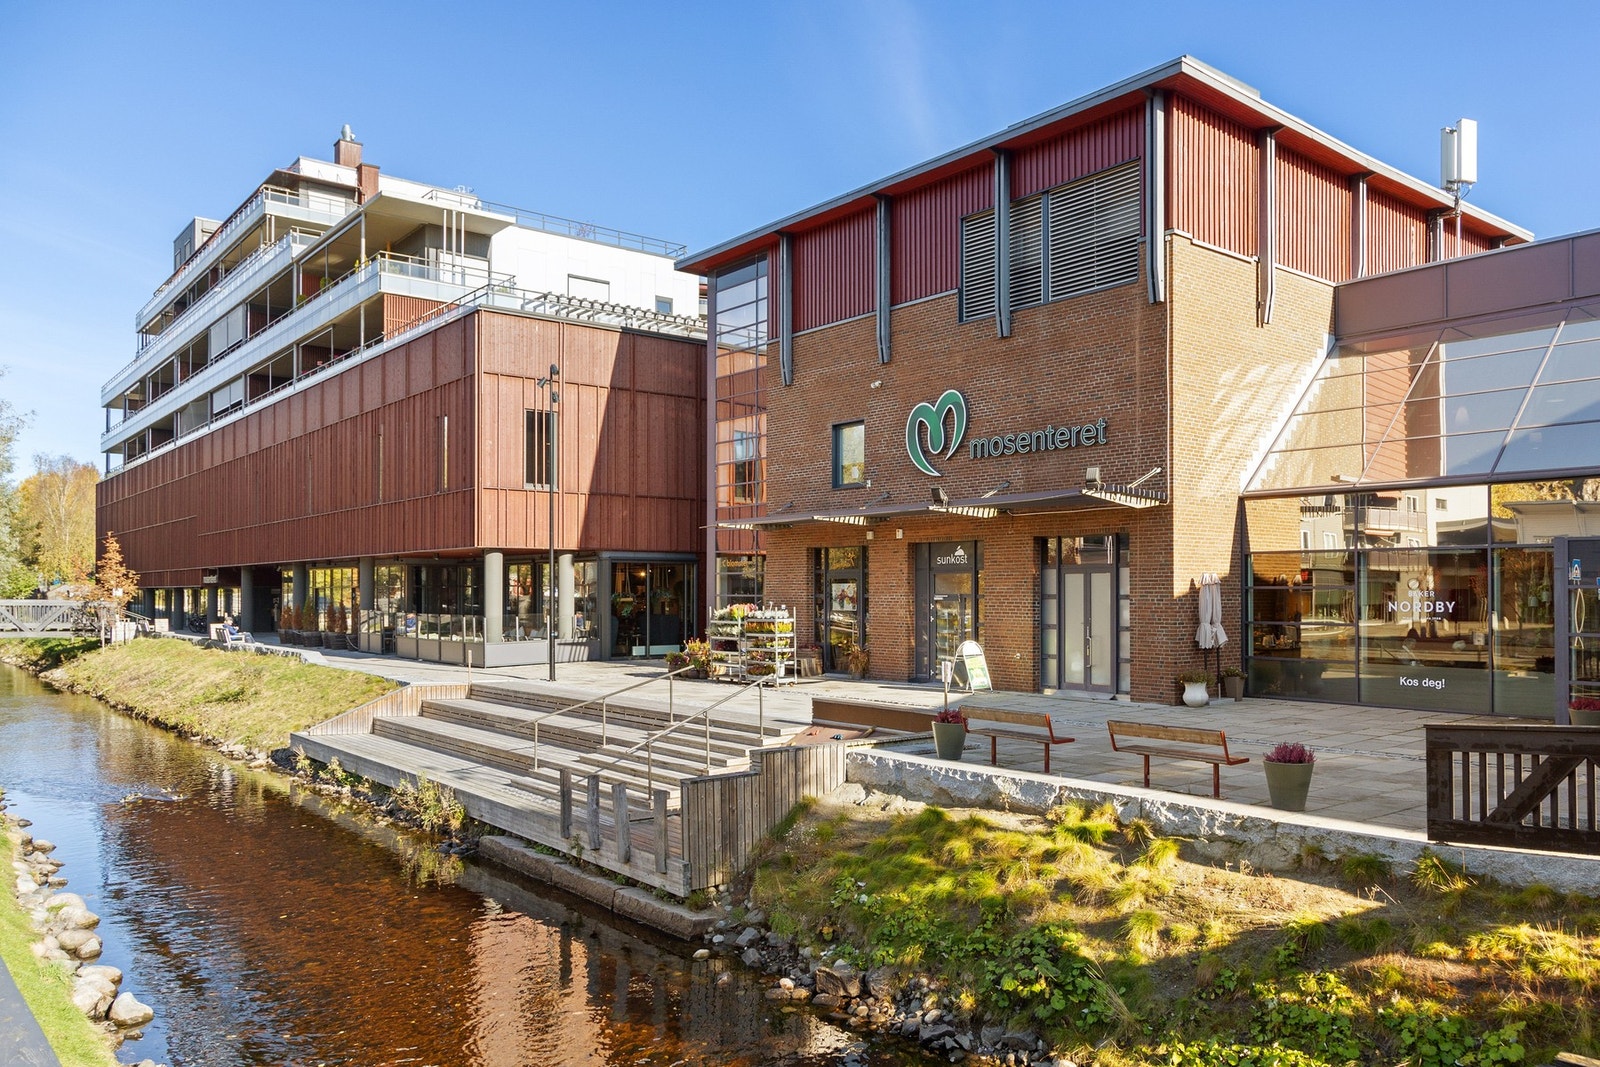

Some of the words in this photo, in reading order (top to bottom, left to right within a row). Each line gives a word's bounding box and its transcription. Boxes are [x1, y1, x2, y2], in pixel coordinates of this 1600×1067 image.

[969, 417, 1107, 459] mosenteret
[937, 554, 968, 565] sunkost
[1388, 601, 1455, 613] NORDBY
[1400, 676, 1419, 686] Kos
[1422, 678, 1445, 689] deg!
